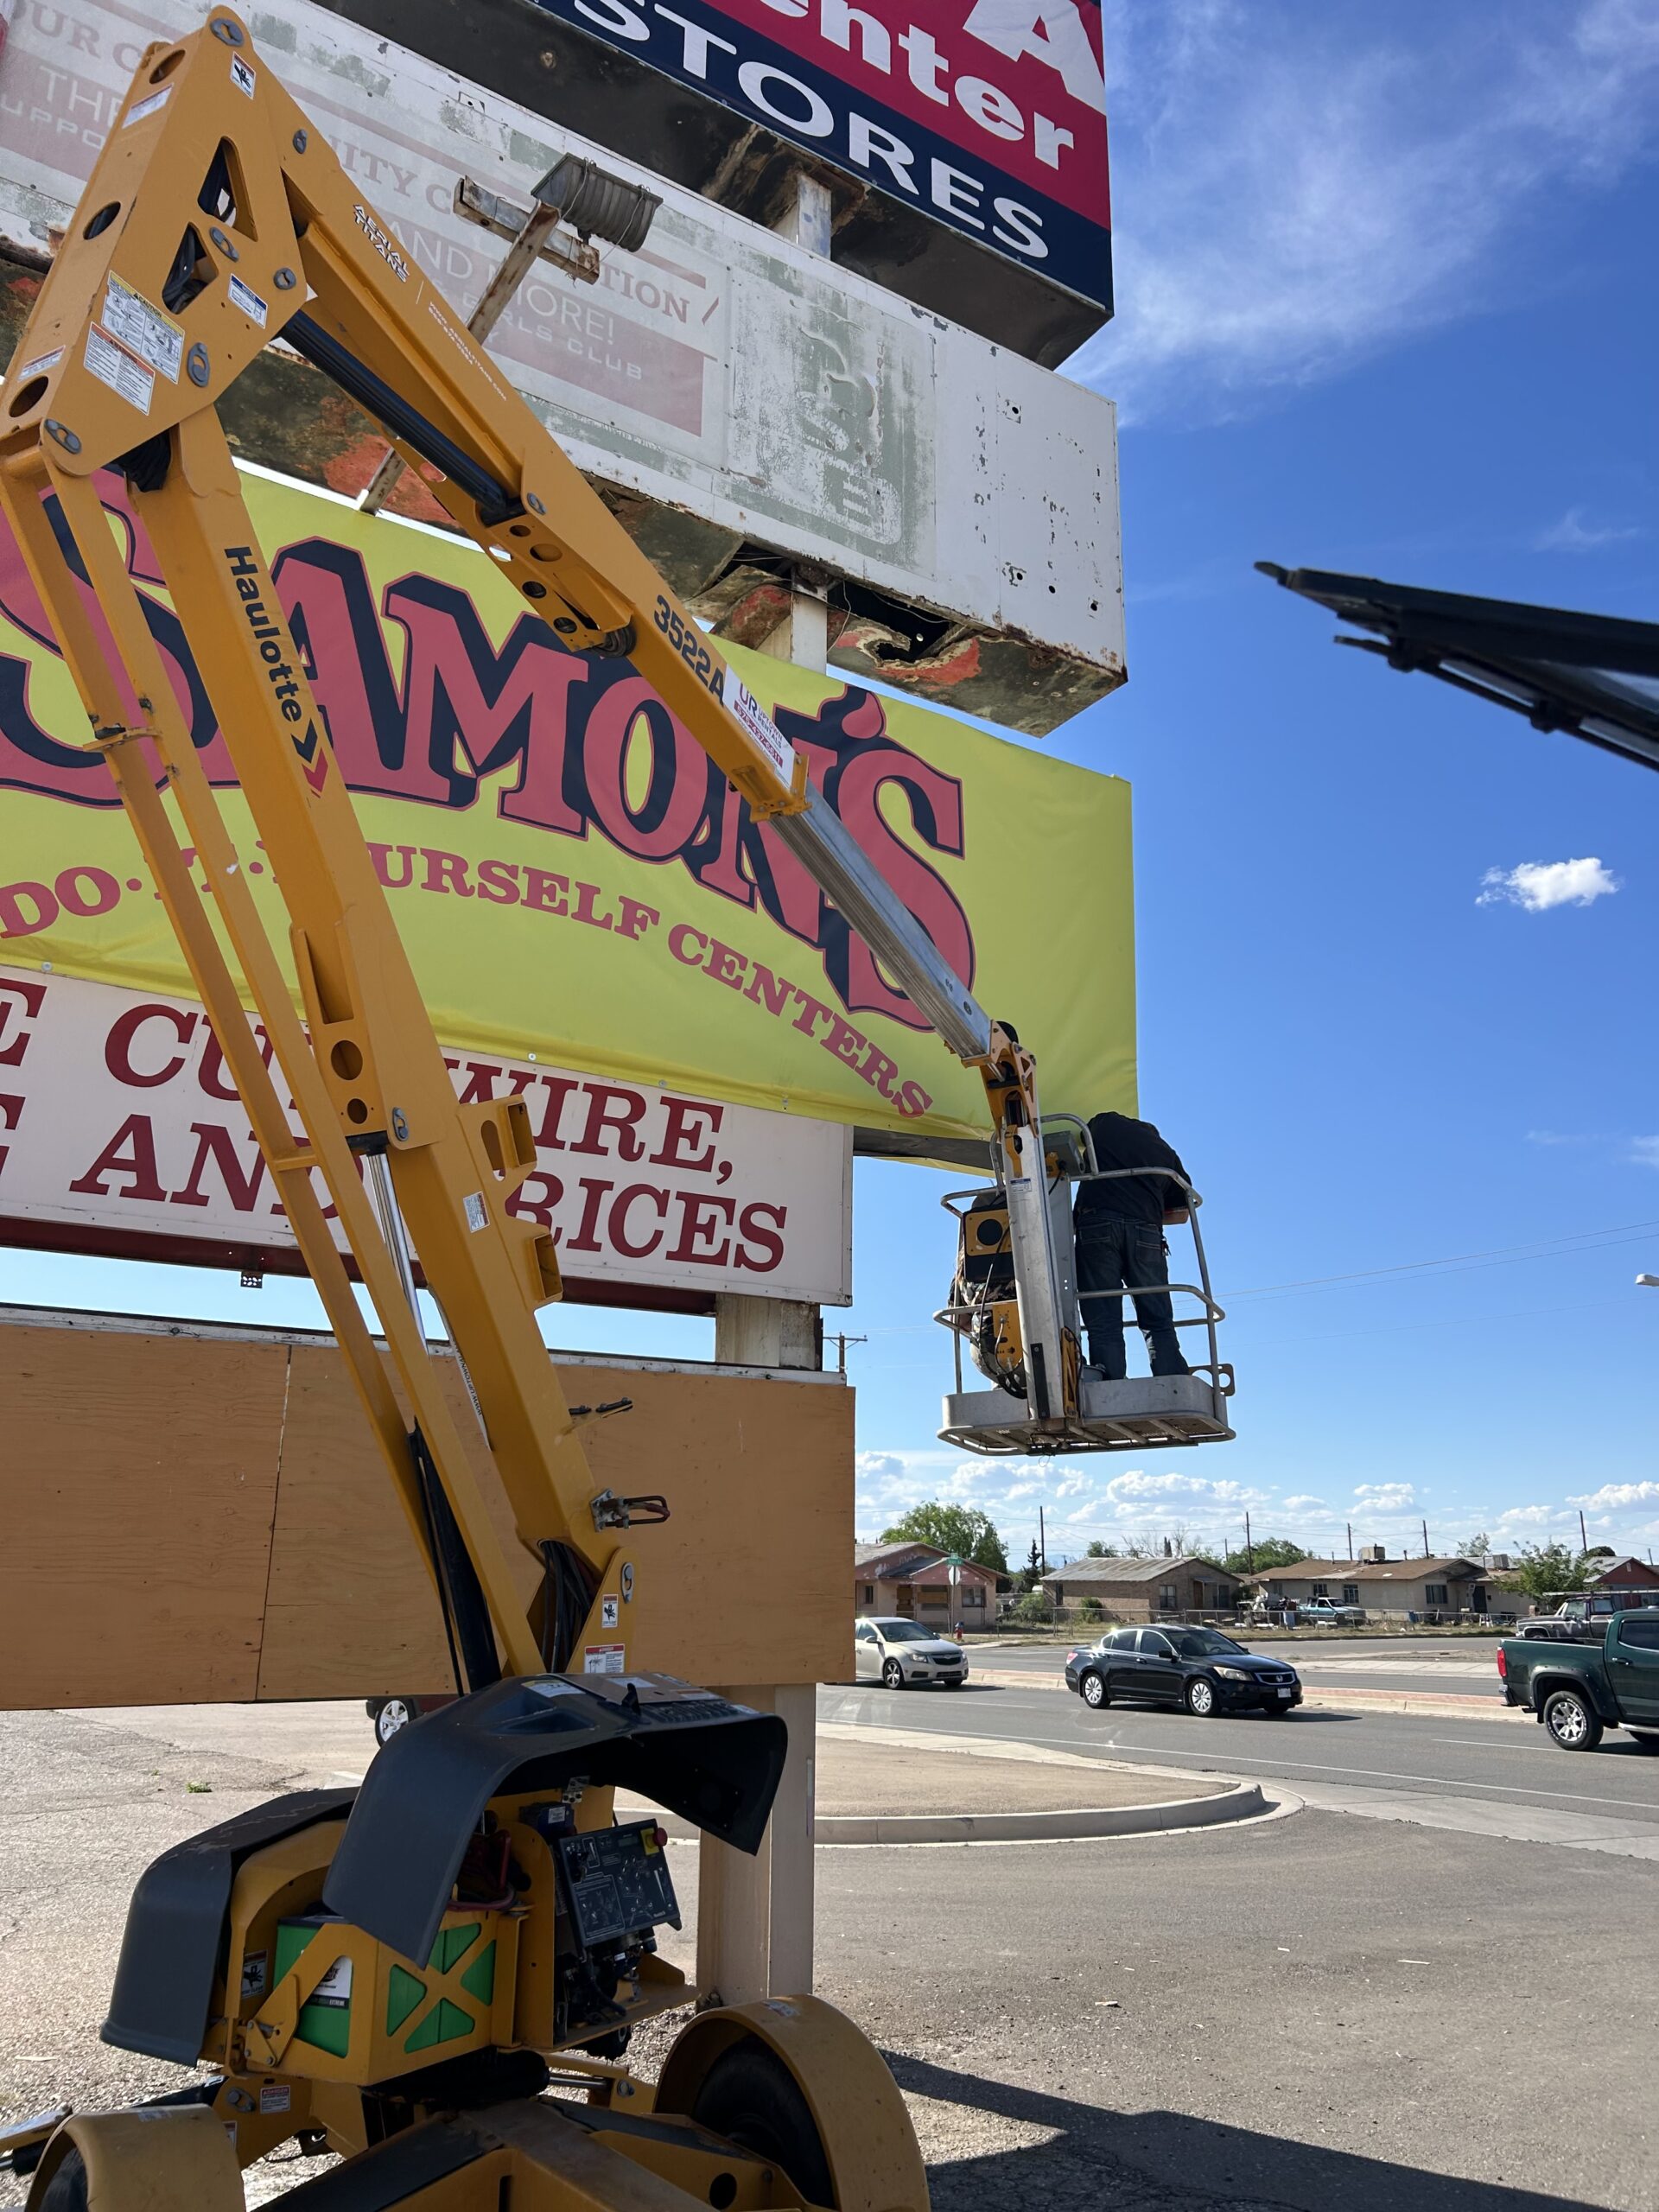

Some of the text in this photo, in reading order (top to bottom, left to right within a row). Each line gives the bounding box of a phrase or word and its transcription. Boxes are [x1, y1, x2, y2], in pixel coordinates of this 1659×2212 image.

[574, 0, 1049, 258] STORES
[353, 204, 410, 276] AERIAL
[353, 211, 407, 283] TITANS
[567, 338, 642, 380] CLUB
[224, 546, 302, 722] Haulotte
[654, 594, 724, 707] 3522A
[740, 683, 758, 717] UR
[668, 924, 933, 1118] CENTERS
